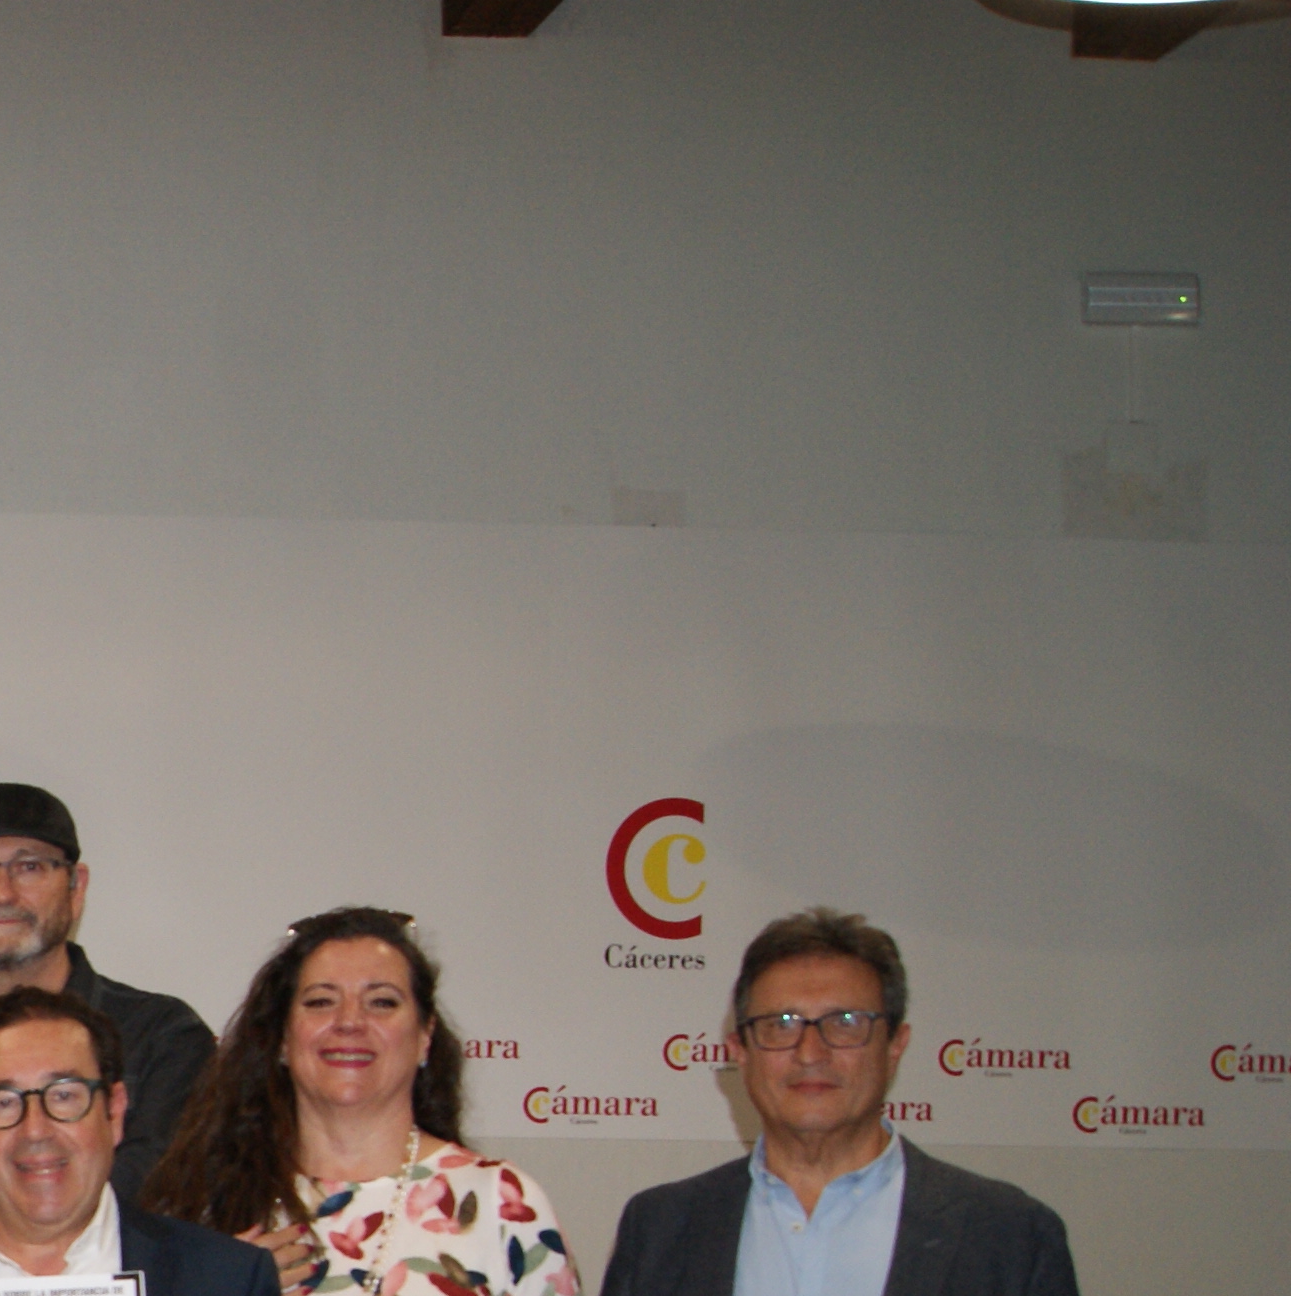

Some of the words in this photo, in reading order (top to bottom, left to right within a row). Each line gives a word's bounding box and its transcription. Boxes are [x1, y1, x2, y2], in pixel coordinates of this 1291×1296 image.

[605, 943, 705, 969] Cáceres
[939, 1038, 1071, 1076] Cámara
[523, 1086, 658, 1123] Cámara
[1072, 1096, 1204, 1133] Cámara
